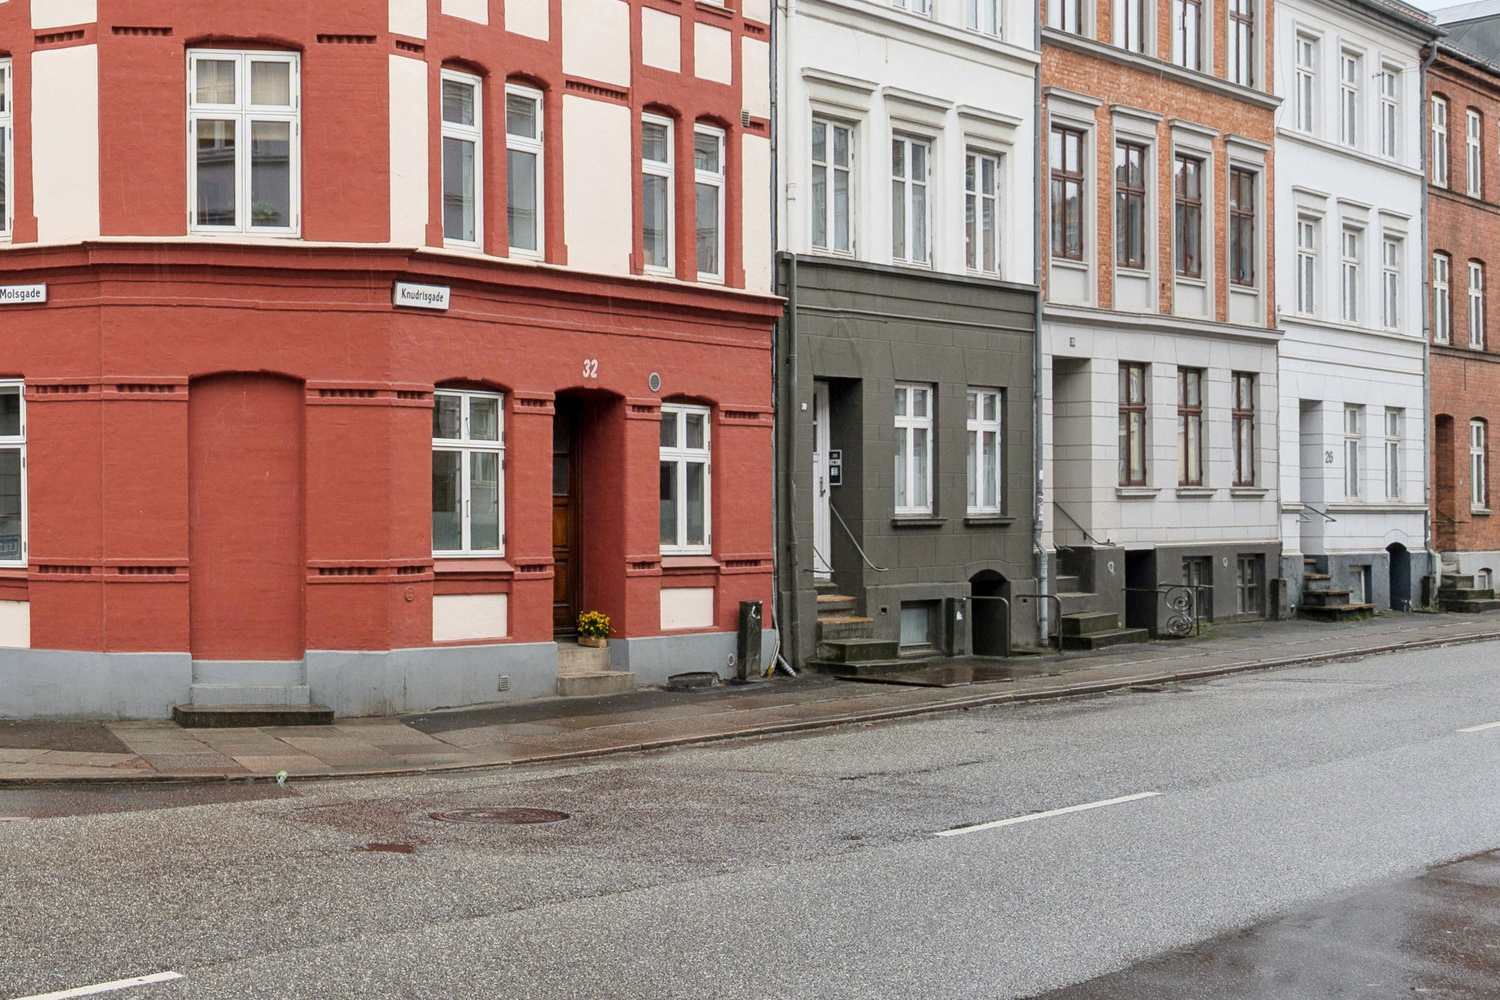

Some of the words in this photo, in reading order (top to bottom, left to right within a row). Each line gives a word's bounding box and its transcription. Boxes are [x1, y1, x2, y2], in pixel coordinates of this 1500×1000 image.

[0, 288, 41, 301] Molsgade
[401, 287, 444, 304] Knudrisgade
[582, 359, 598, 378] 32
[1325, 450, 1334, 464] 26
